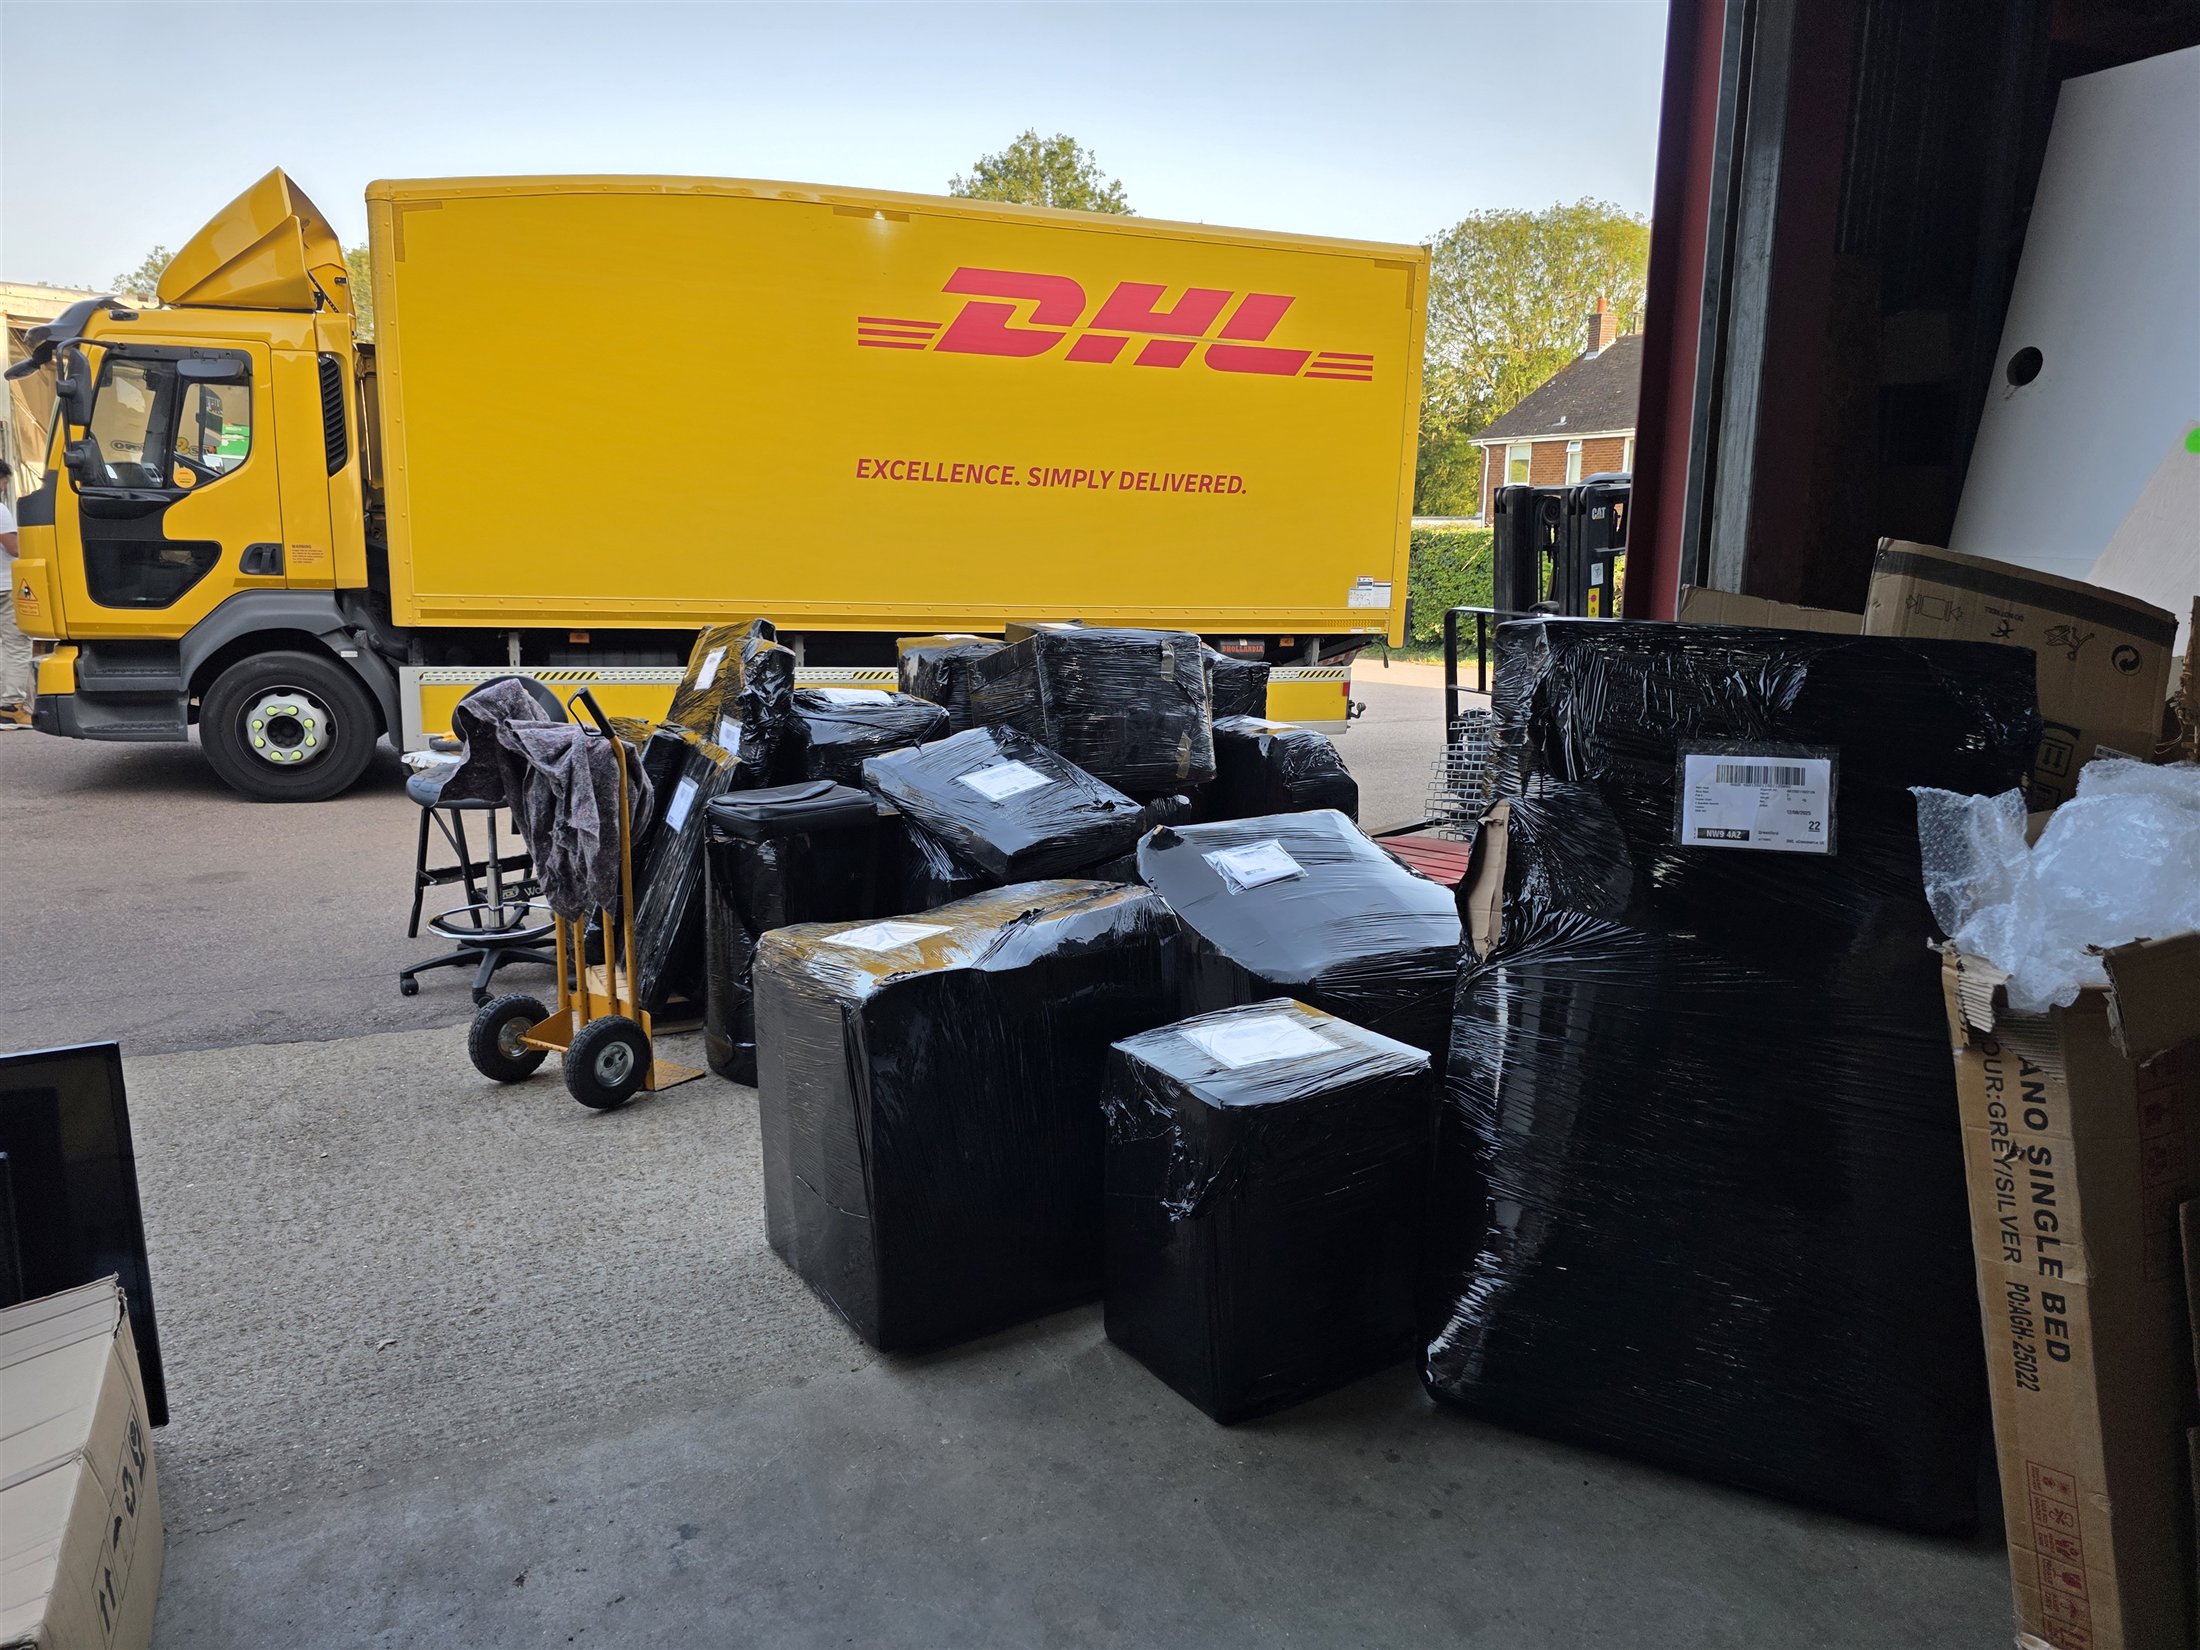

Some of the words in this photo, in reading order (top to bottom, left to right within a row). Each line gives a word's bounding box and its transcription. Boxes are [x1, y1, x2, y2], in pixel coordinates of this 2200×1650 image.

[933, 267, 1312, 376] DHL
[856, 457, 1020, 487] EXCELLENCE.
[1026, 466, 1115, 490] SIMPLY
[1118, 471, 1247, 495] DELIVERED.
[1591, 506, 1606, 520] CAT
[1706, 829, 1725, 838] NW9
[1726, 830, 1742, 839] 4AZ
[1808, 820, 1821, 831] 22
[2027, 1144, 2064, 1280] SINGLE
[2040, 1290, 2071, 1364] BED
